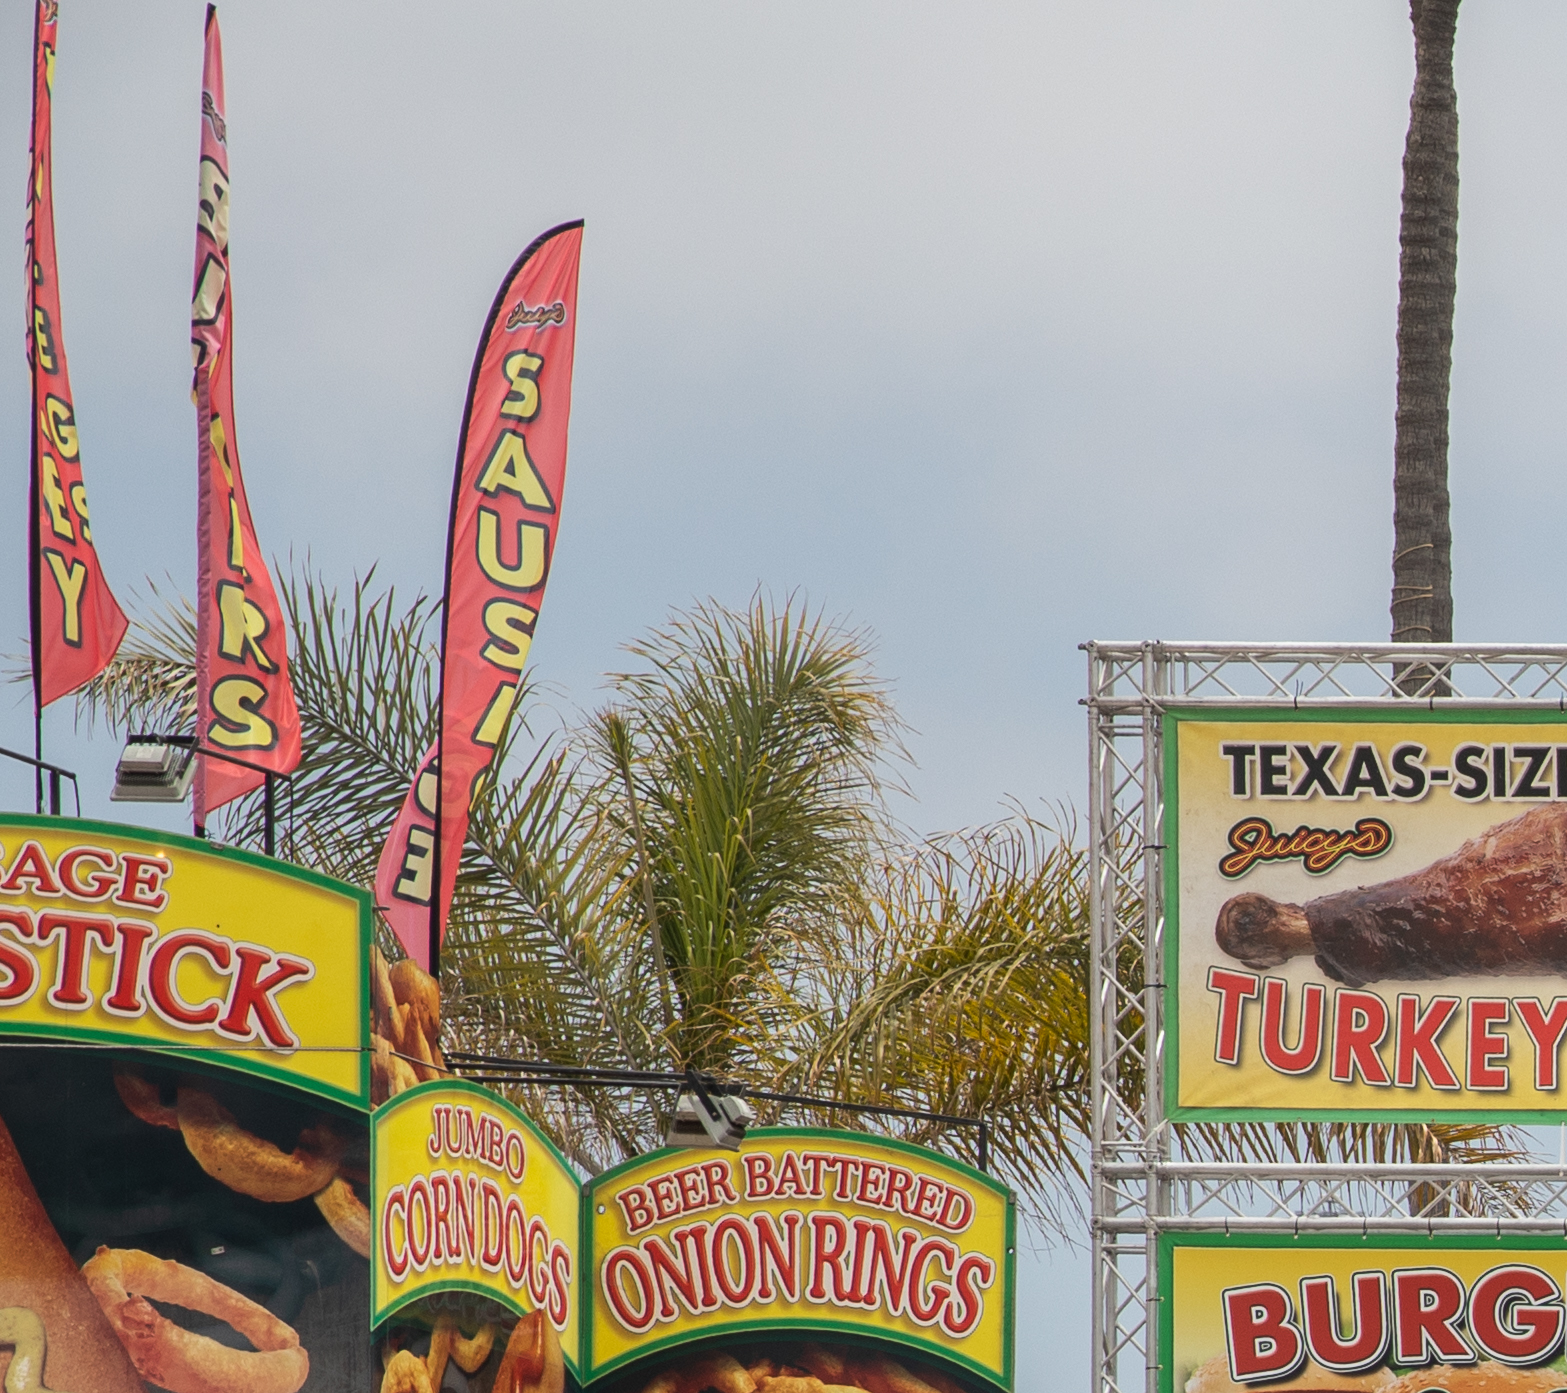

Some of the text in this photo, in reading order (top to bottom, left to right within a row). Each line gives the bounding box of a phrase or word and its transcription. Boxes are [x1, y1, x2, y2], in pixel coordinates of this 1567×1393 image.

[427, 1103, 527, 1184] JUMBO
[617, 1150, 976, 1237] BEER BATTERED
[600, 1208, 998, 1338] ONION RINGS
